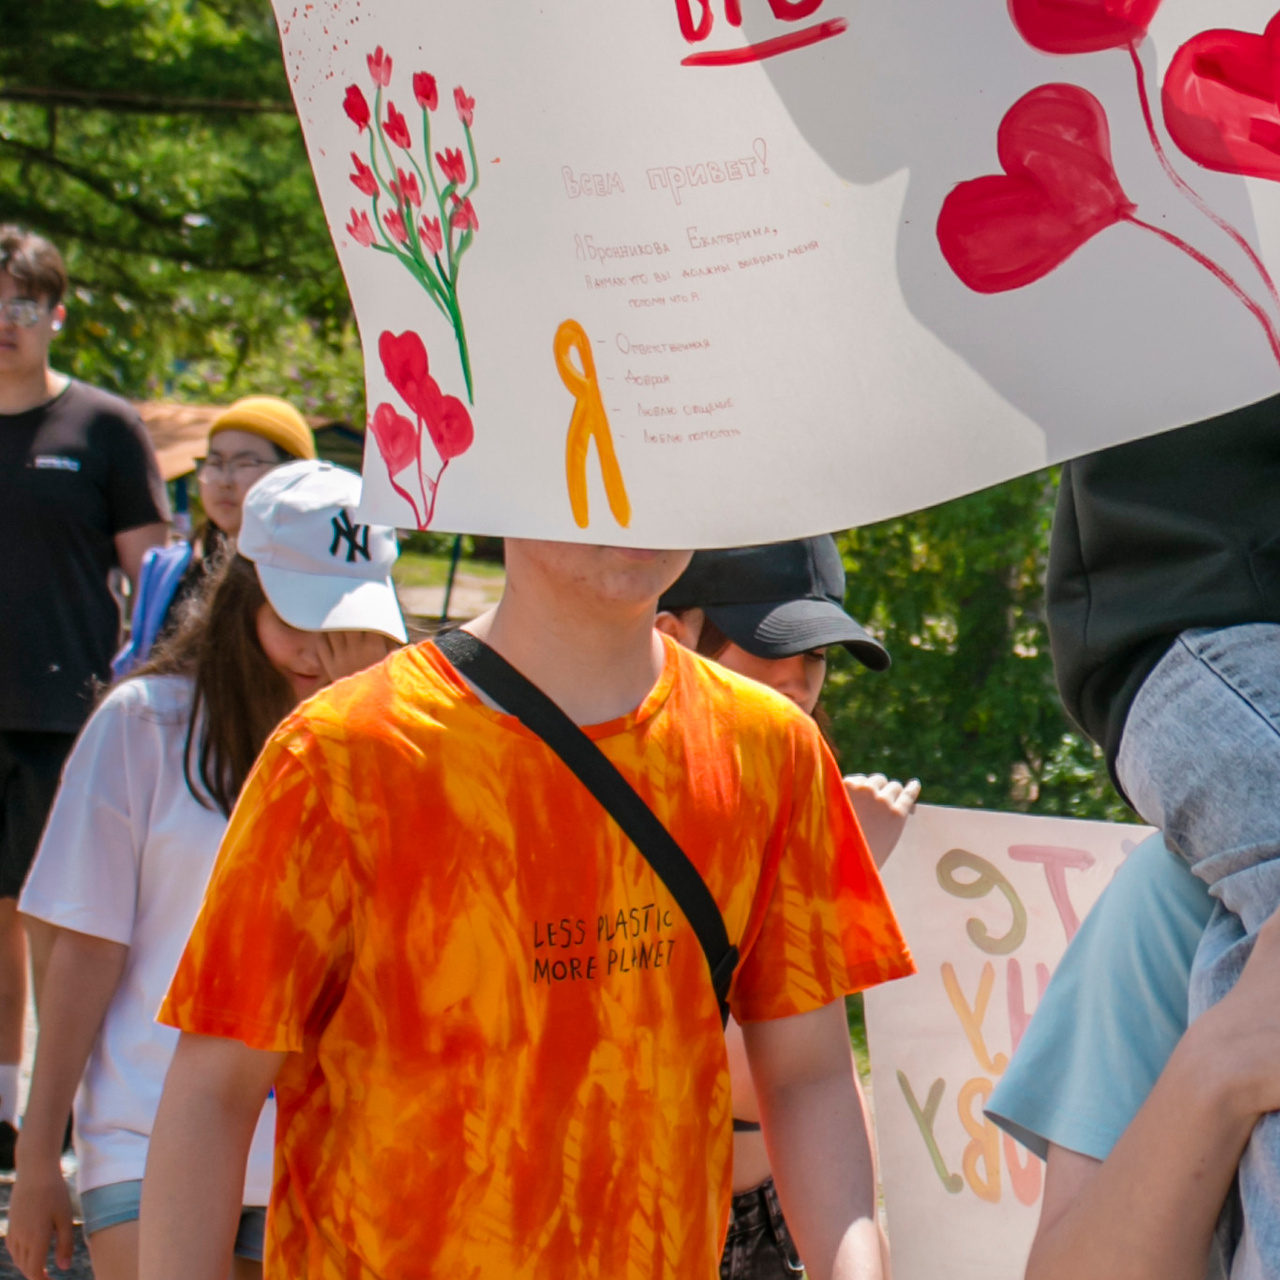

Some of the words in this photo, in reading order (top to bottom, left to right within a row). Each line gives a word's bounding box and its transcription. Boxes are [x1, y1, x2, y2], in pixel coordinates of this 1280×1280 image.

[534, 918, 586, 949] LESS
[597, 903, 674, 942] PLASTIC
[533, 956, 598, 985] MORE
[606, 939, 676, 976] PLANET
